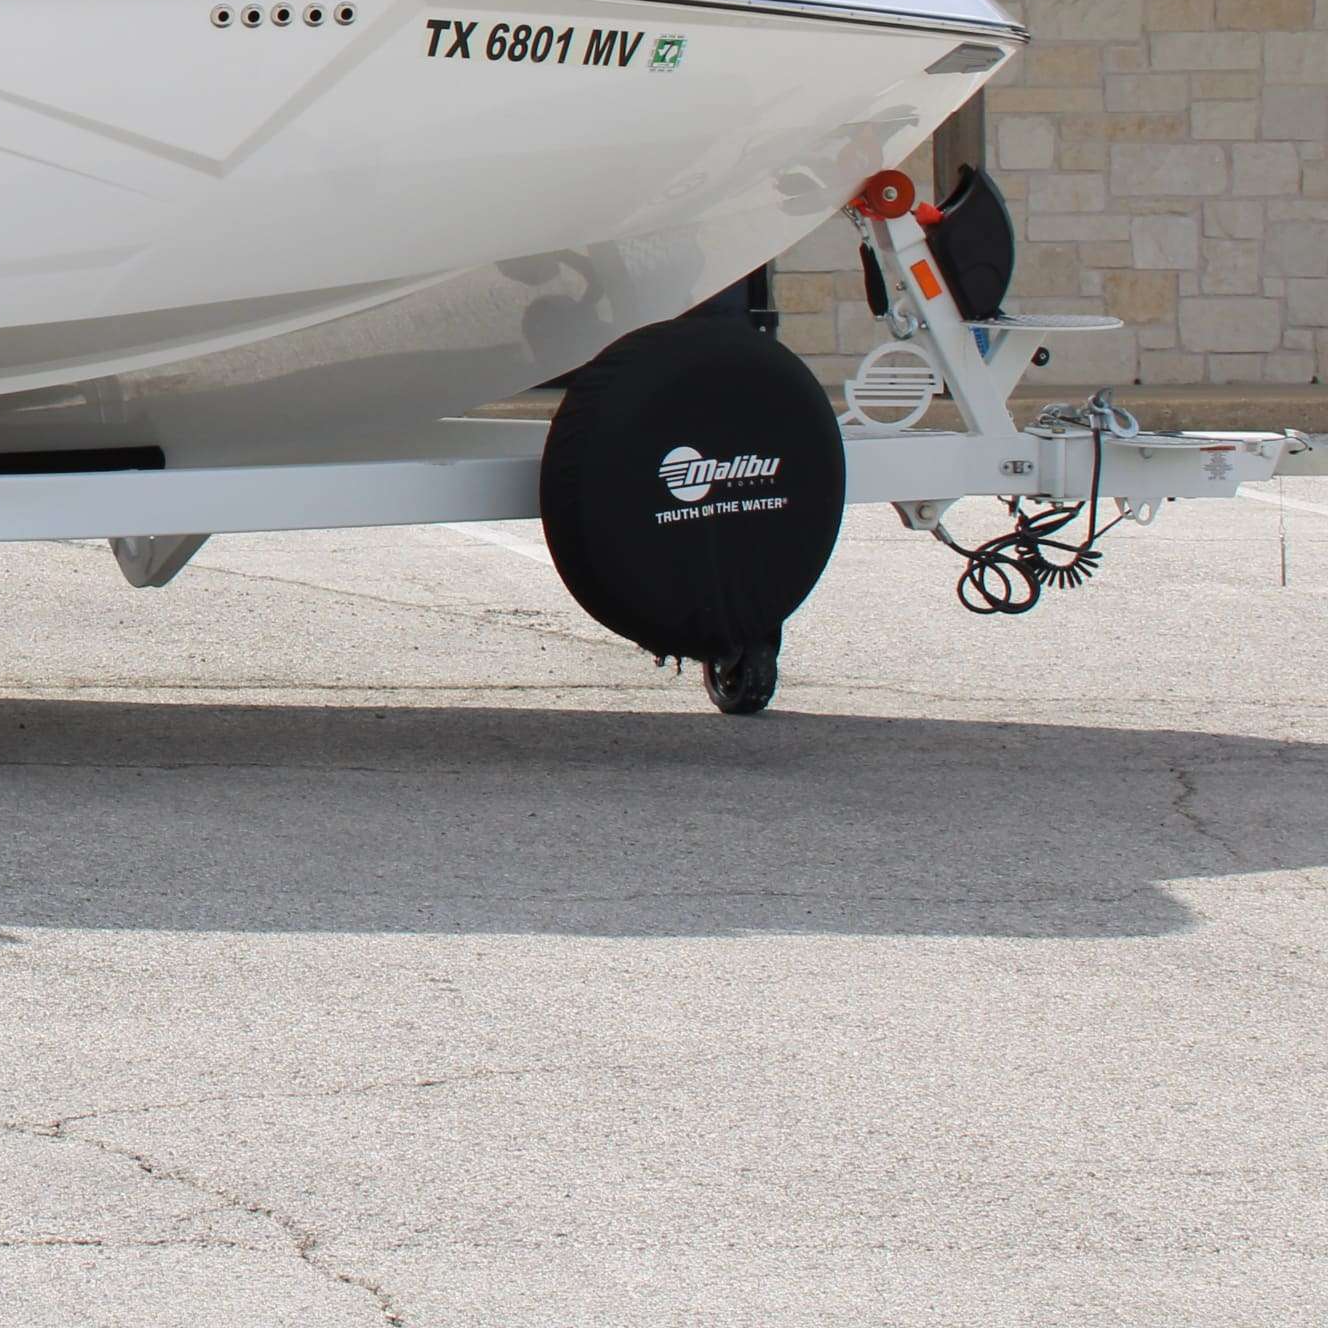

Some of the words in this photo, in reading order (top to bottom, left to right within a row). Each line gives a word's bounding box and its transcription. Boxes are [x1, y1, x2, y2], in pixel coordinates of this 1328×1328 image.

[426, 19, 479, 59] TX
[485, 23, 575, 64] 6801
[582, 29, 646, 68] MV
[684, 455, 781, 486] Malibu
[655, 507, 700, 525] TRUTH
[702, 503, 714, 517] ON
[716, 501, 739, 514] THE
